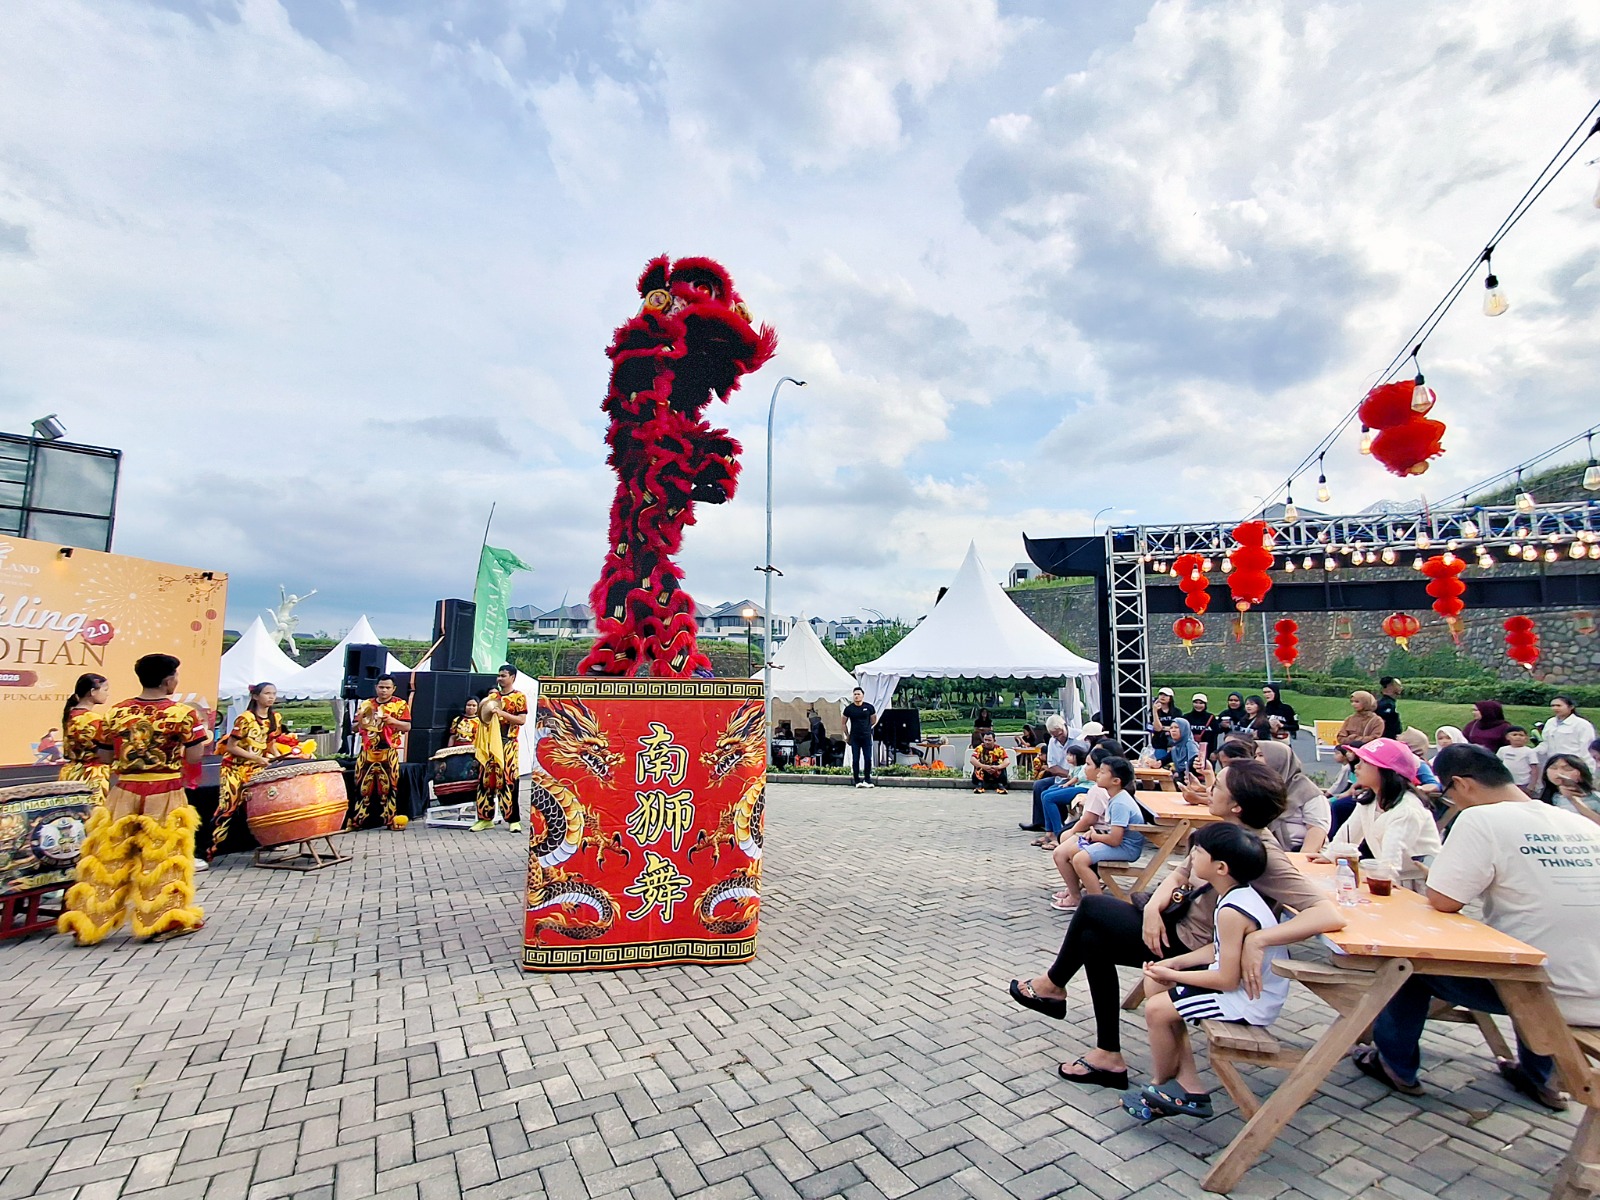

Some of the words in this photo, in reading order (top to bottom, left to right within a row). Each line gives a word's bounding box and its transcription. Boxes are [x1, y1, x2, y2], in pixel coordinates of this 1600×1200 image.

[87, 623, 110, 638] 2.0
[4, 693, 52, 701] PUNCAK
[625, 722, 693, 922] 南狮舞
[1524, 833, 1563, 842] FARM
[1520, 846, 1558, 855] ONLY
[1563, 846, 1590, 855] GOD
[1538, 858, 1594, 868] THINGS
